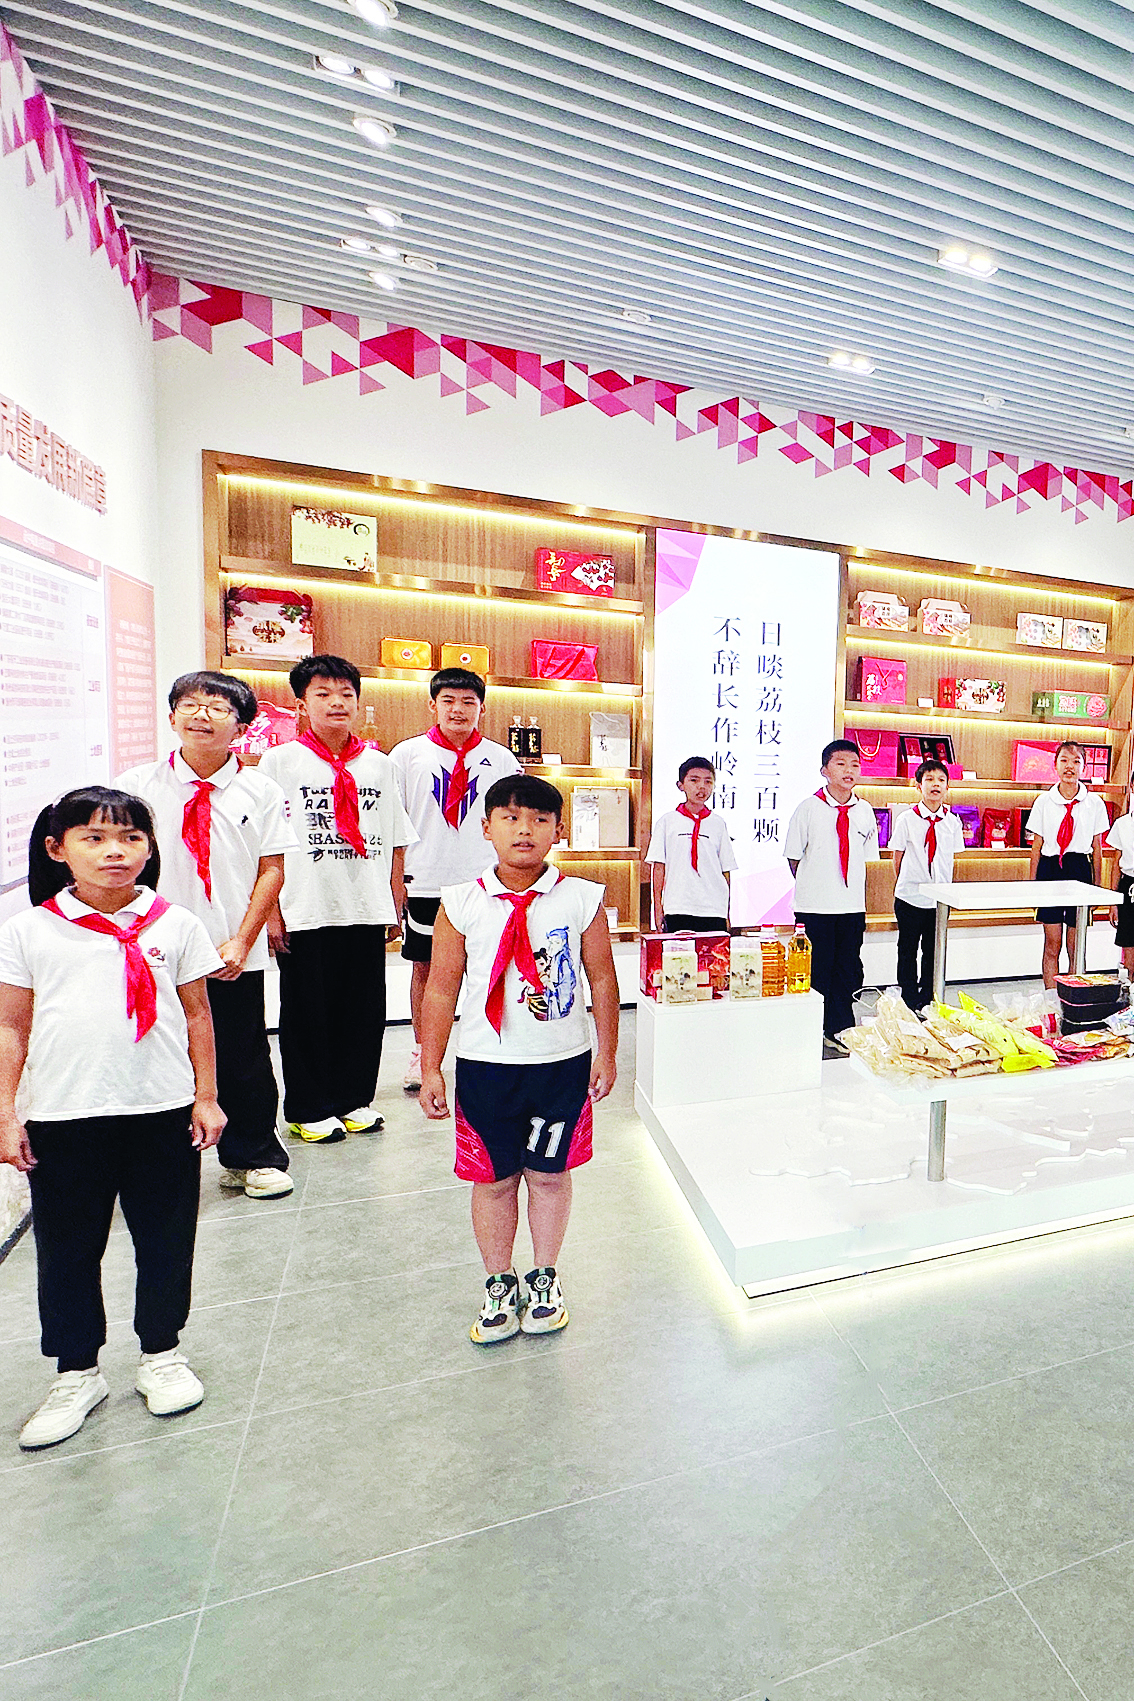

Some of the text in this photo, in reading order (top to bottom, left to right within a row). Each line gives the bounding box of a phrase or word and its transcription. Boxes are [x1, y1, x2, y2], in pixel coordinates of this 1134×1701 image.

[711, 616, 742, 842] 不辞长作岭南
[753, 621, 784, 843] 日啖荔枝三百颗
[526, 1116, 565, 1158] 11
